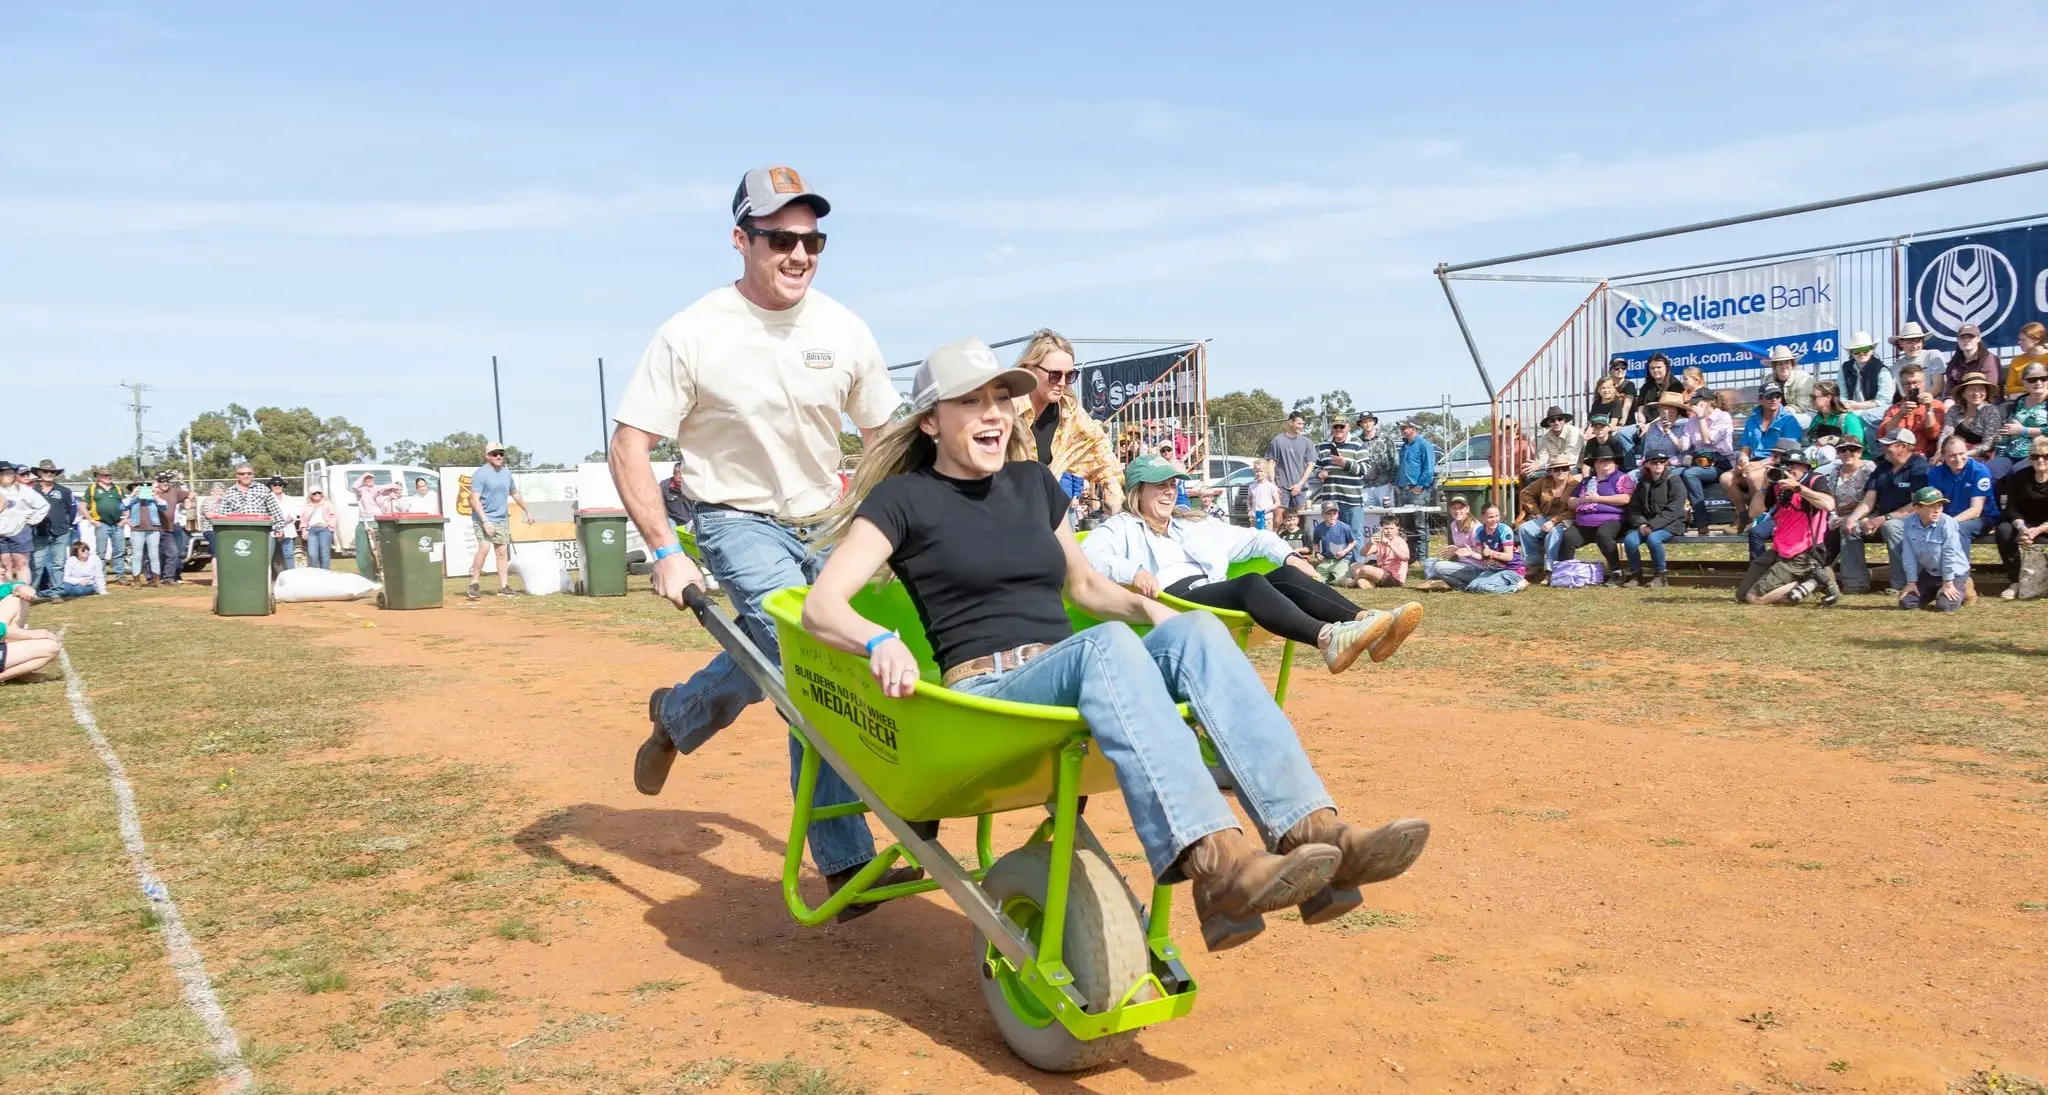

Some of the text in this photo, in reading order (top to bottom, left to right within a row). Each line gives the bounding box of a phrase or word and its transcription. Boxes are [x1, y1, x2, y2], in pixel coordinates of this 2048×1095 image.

[1661, 276, 1832, 322] Reliance Bank
[1789, 341, 1809, 356] 24
[1812, 338, 1834, 354] 40
[794, 664, 836, 692] BUILDERS
[837, 684, 849, 701] NO
[868, 704, 900, 733] WHEEL
[810, 683, 899, 752] MEDALTECH
